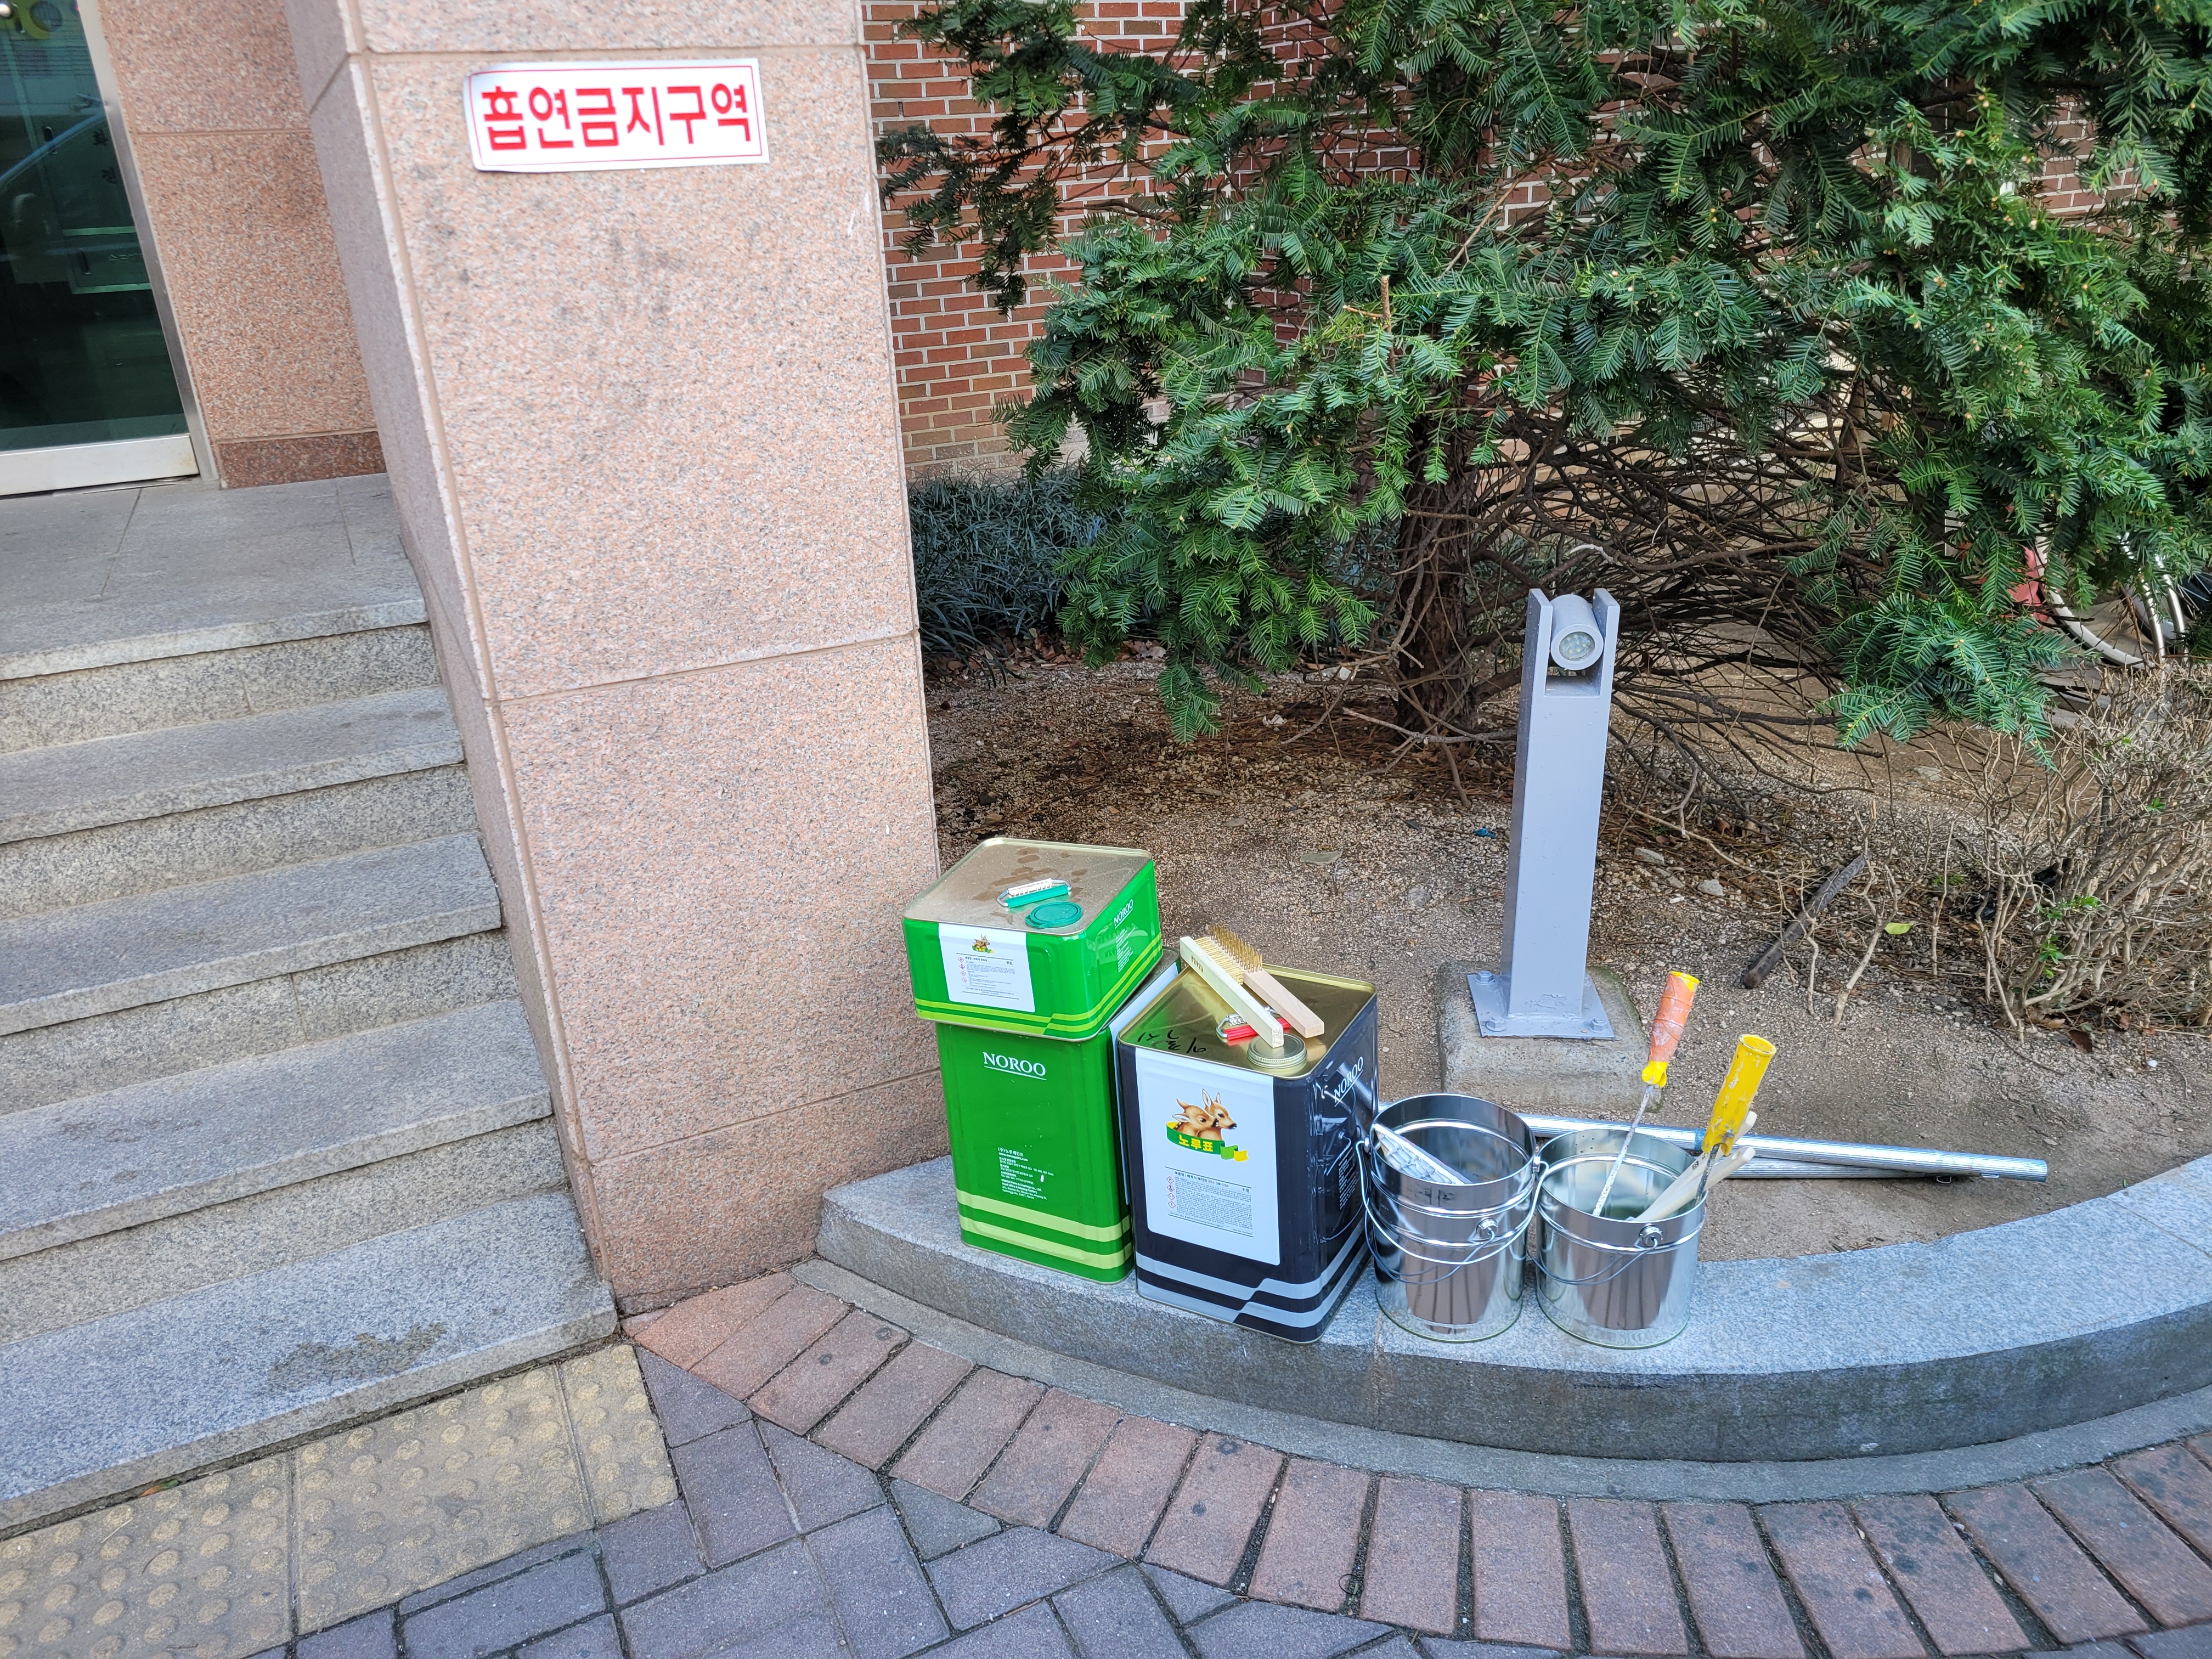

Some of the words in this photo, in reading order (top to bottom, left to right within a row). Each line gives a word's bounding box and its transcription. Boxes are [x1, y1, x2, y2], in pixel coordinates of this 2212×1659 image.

[481, 83, 751, 151] 흡연금지구역
[1114, 899, 1133, 927] NOROO
[983, 1052, 1046, 1076] NOROO
[1334, 1056, 1364, 1104] NOROO
[1179, 1135, 1214, 1152] 노루표
